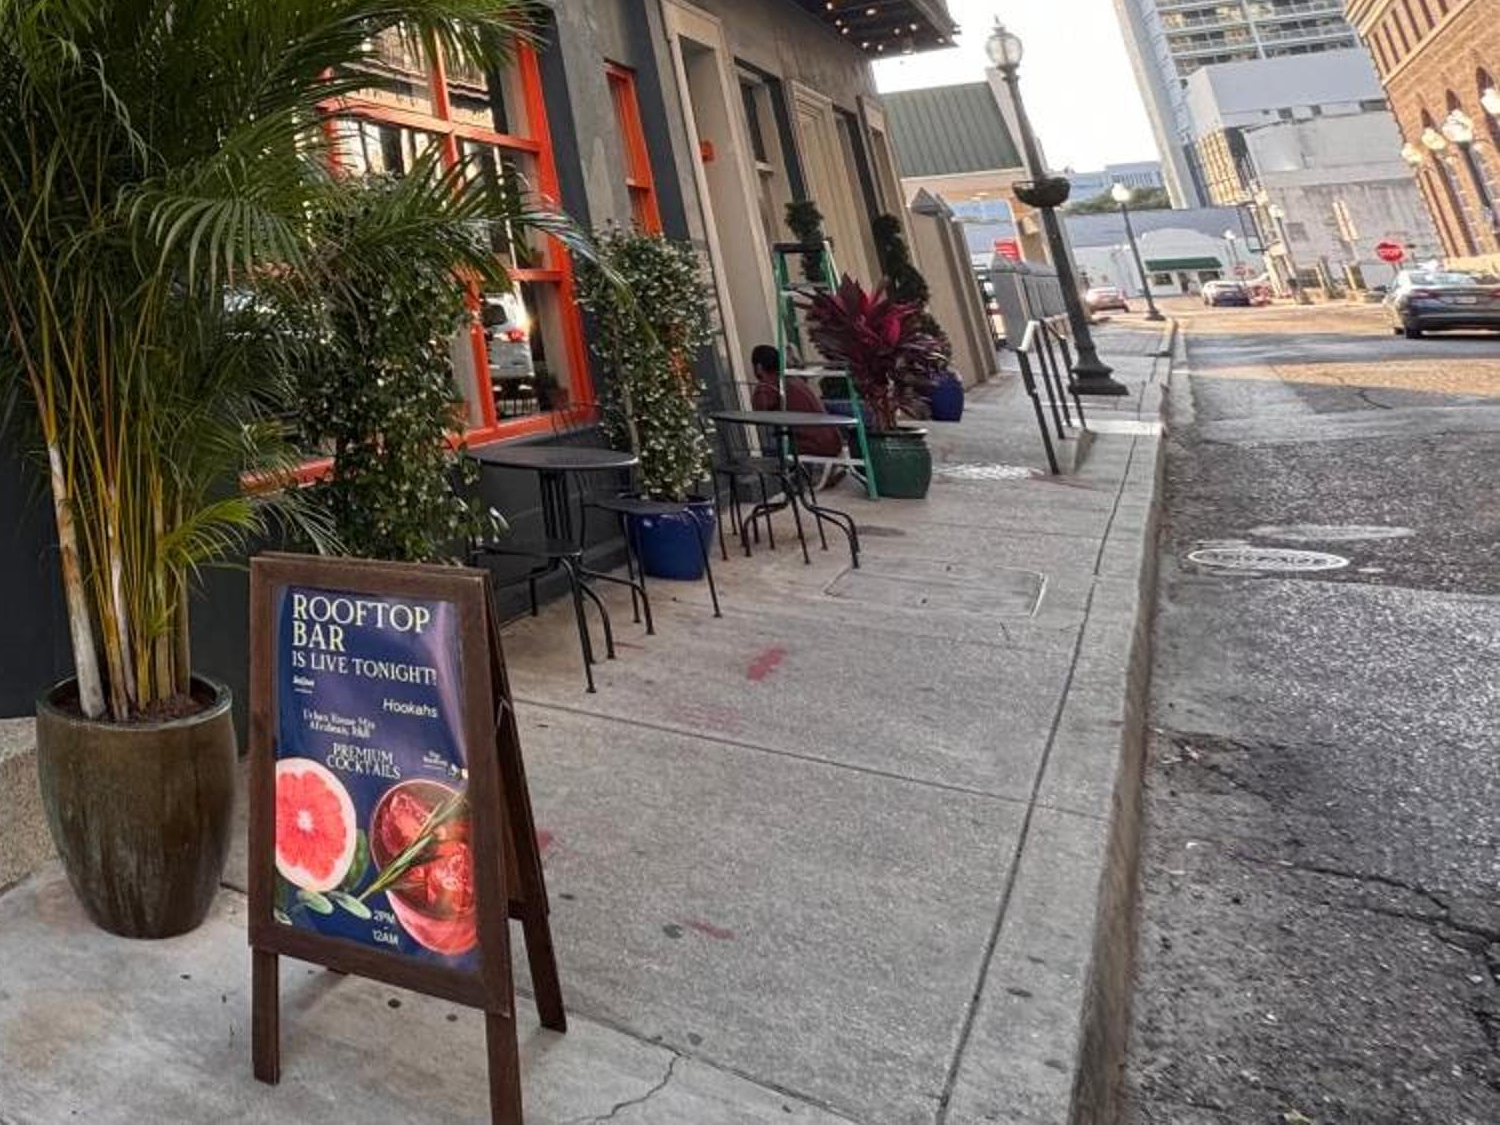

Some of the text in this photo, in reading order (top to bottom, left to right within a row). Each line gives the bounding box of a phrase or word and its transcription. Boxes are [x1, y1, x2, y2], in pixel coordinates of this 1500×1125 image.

[292, 593, 431, 634] ROOFTOP
[292, 620, 346, 652] BAR
[292, 650, 437, 687] IS LIVE TONIGHT!
[383, 698, 438, 718] Hookahs
[326, 754, 402, 780] COCKTAILS
[332, 742, 394, 765] PREMIUM
